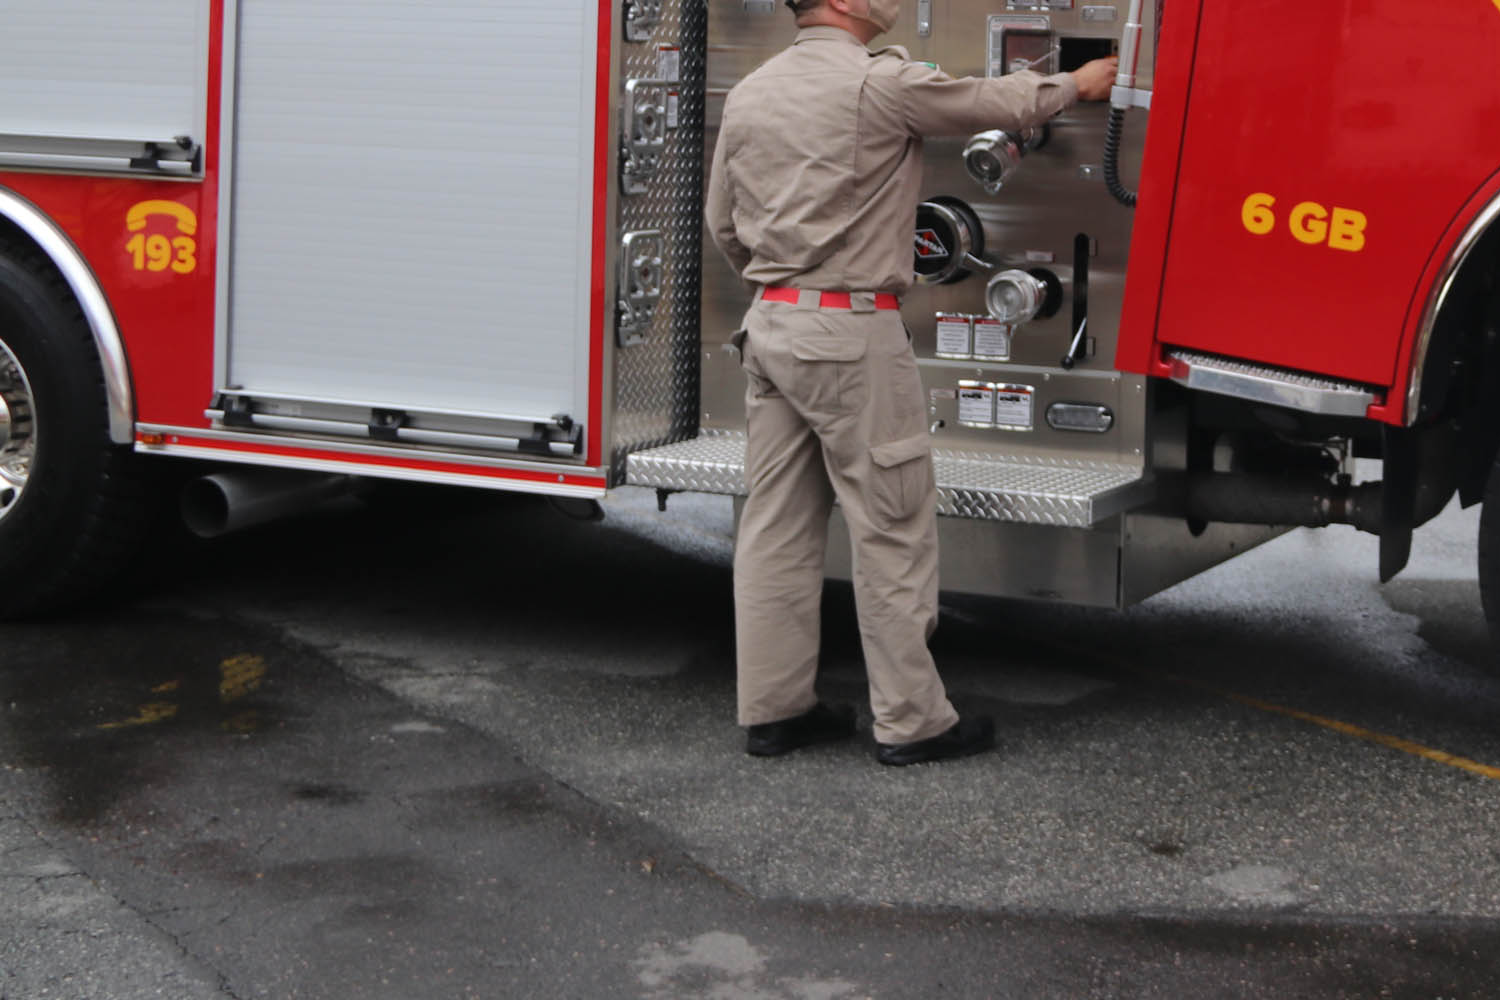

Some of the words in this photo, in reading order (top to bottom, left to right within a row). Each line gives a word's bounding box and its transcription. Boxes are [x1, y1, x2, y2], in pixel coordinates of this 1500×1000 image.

[1241, 192, 1276, 236] 6
[1289, 201, 1368, 252] GB
[125, 233, 197, 274] 193
